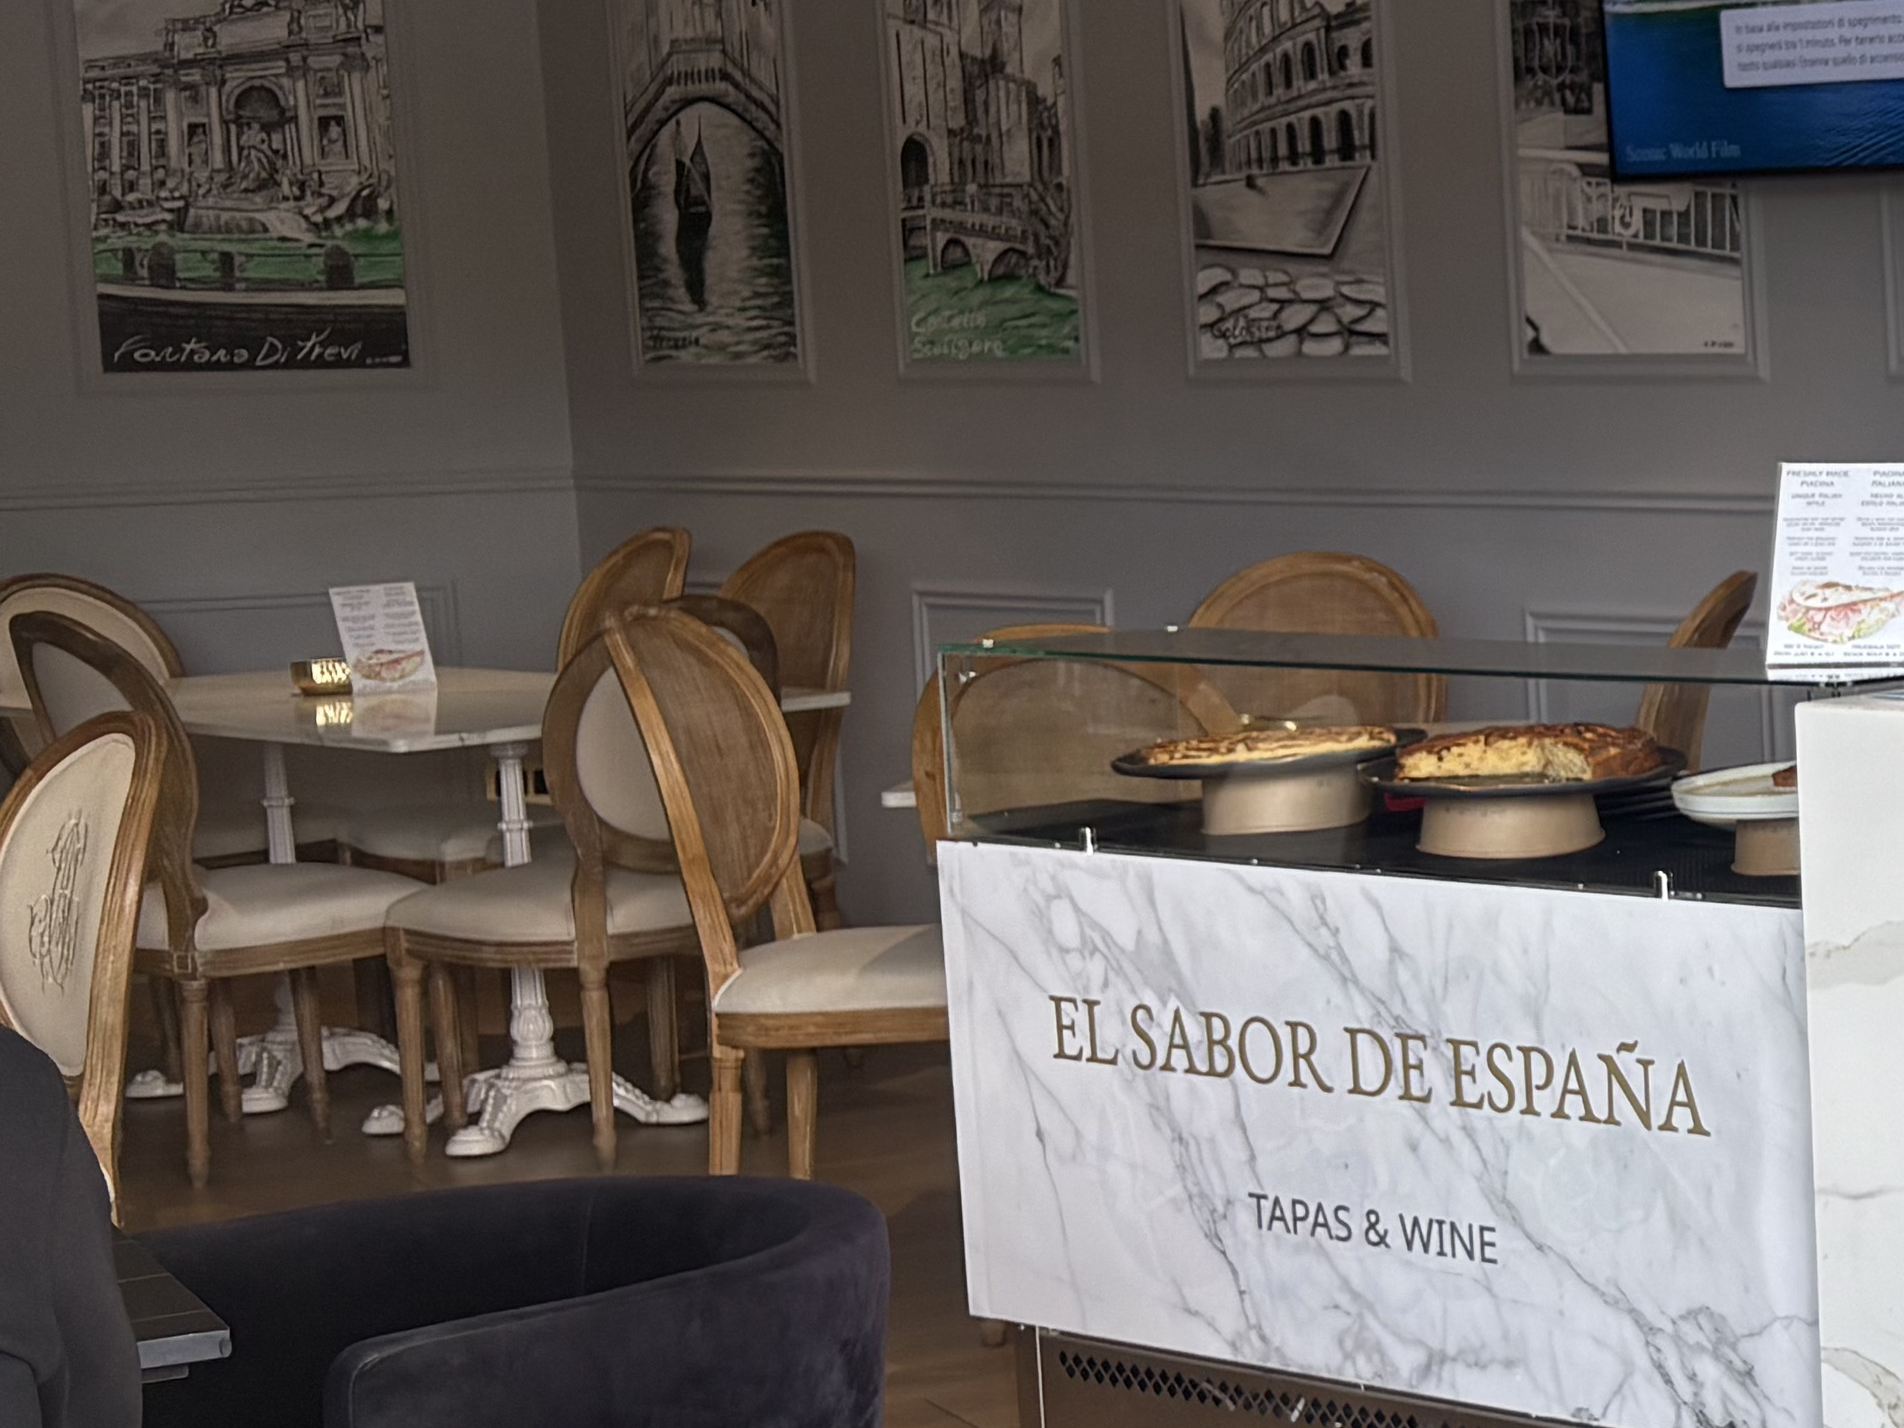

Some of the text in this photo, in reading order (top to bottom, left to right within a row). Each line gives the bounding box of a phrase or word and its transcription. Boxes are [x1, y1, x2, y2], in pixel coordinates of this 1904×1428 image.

[1048, 993, 1713, 1138] EL SABOR DE ESPAÑA
[1247, 1191, 1499, 1266] TAPAS & WINE
